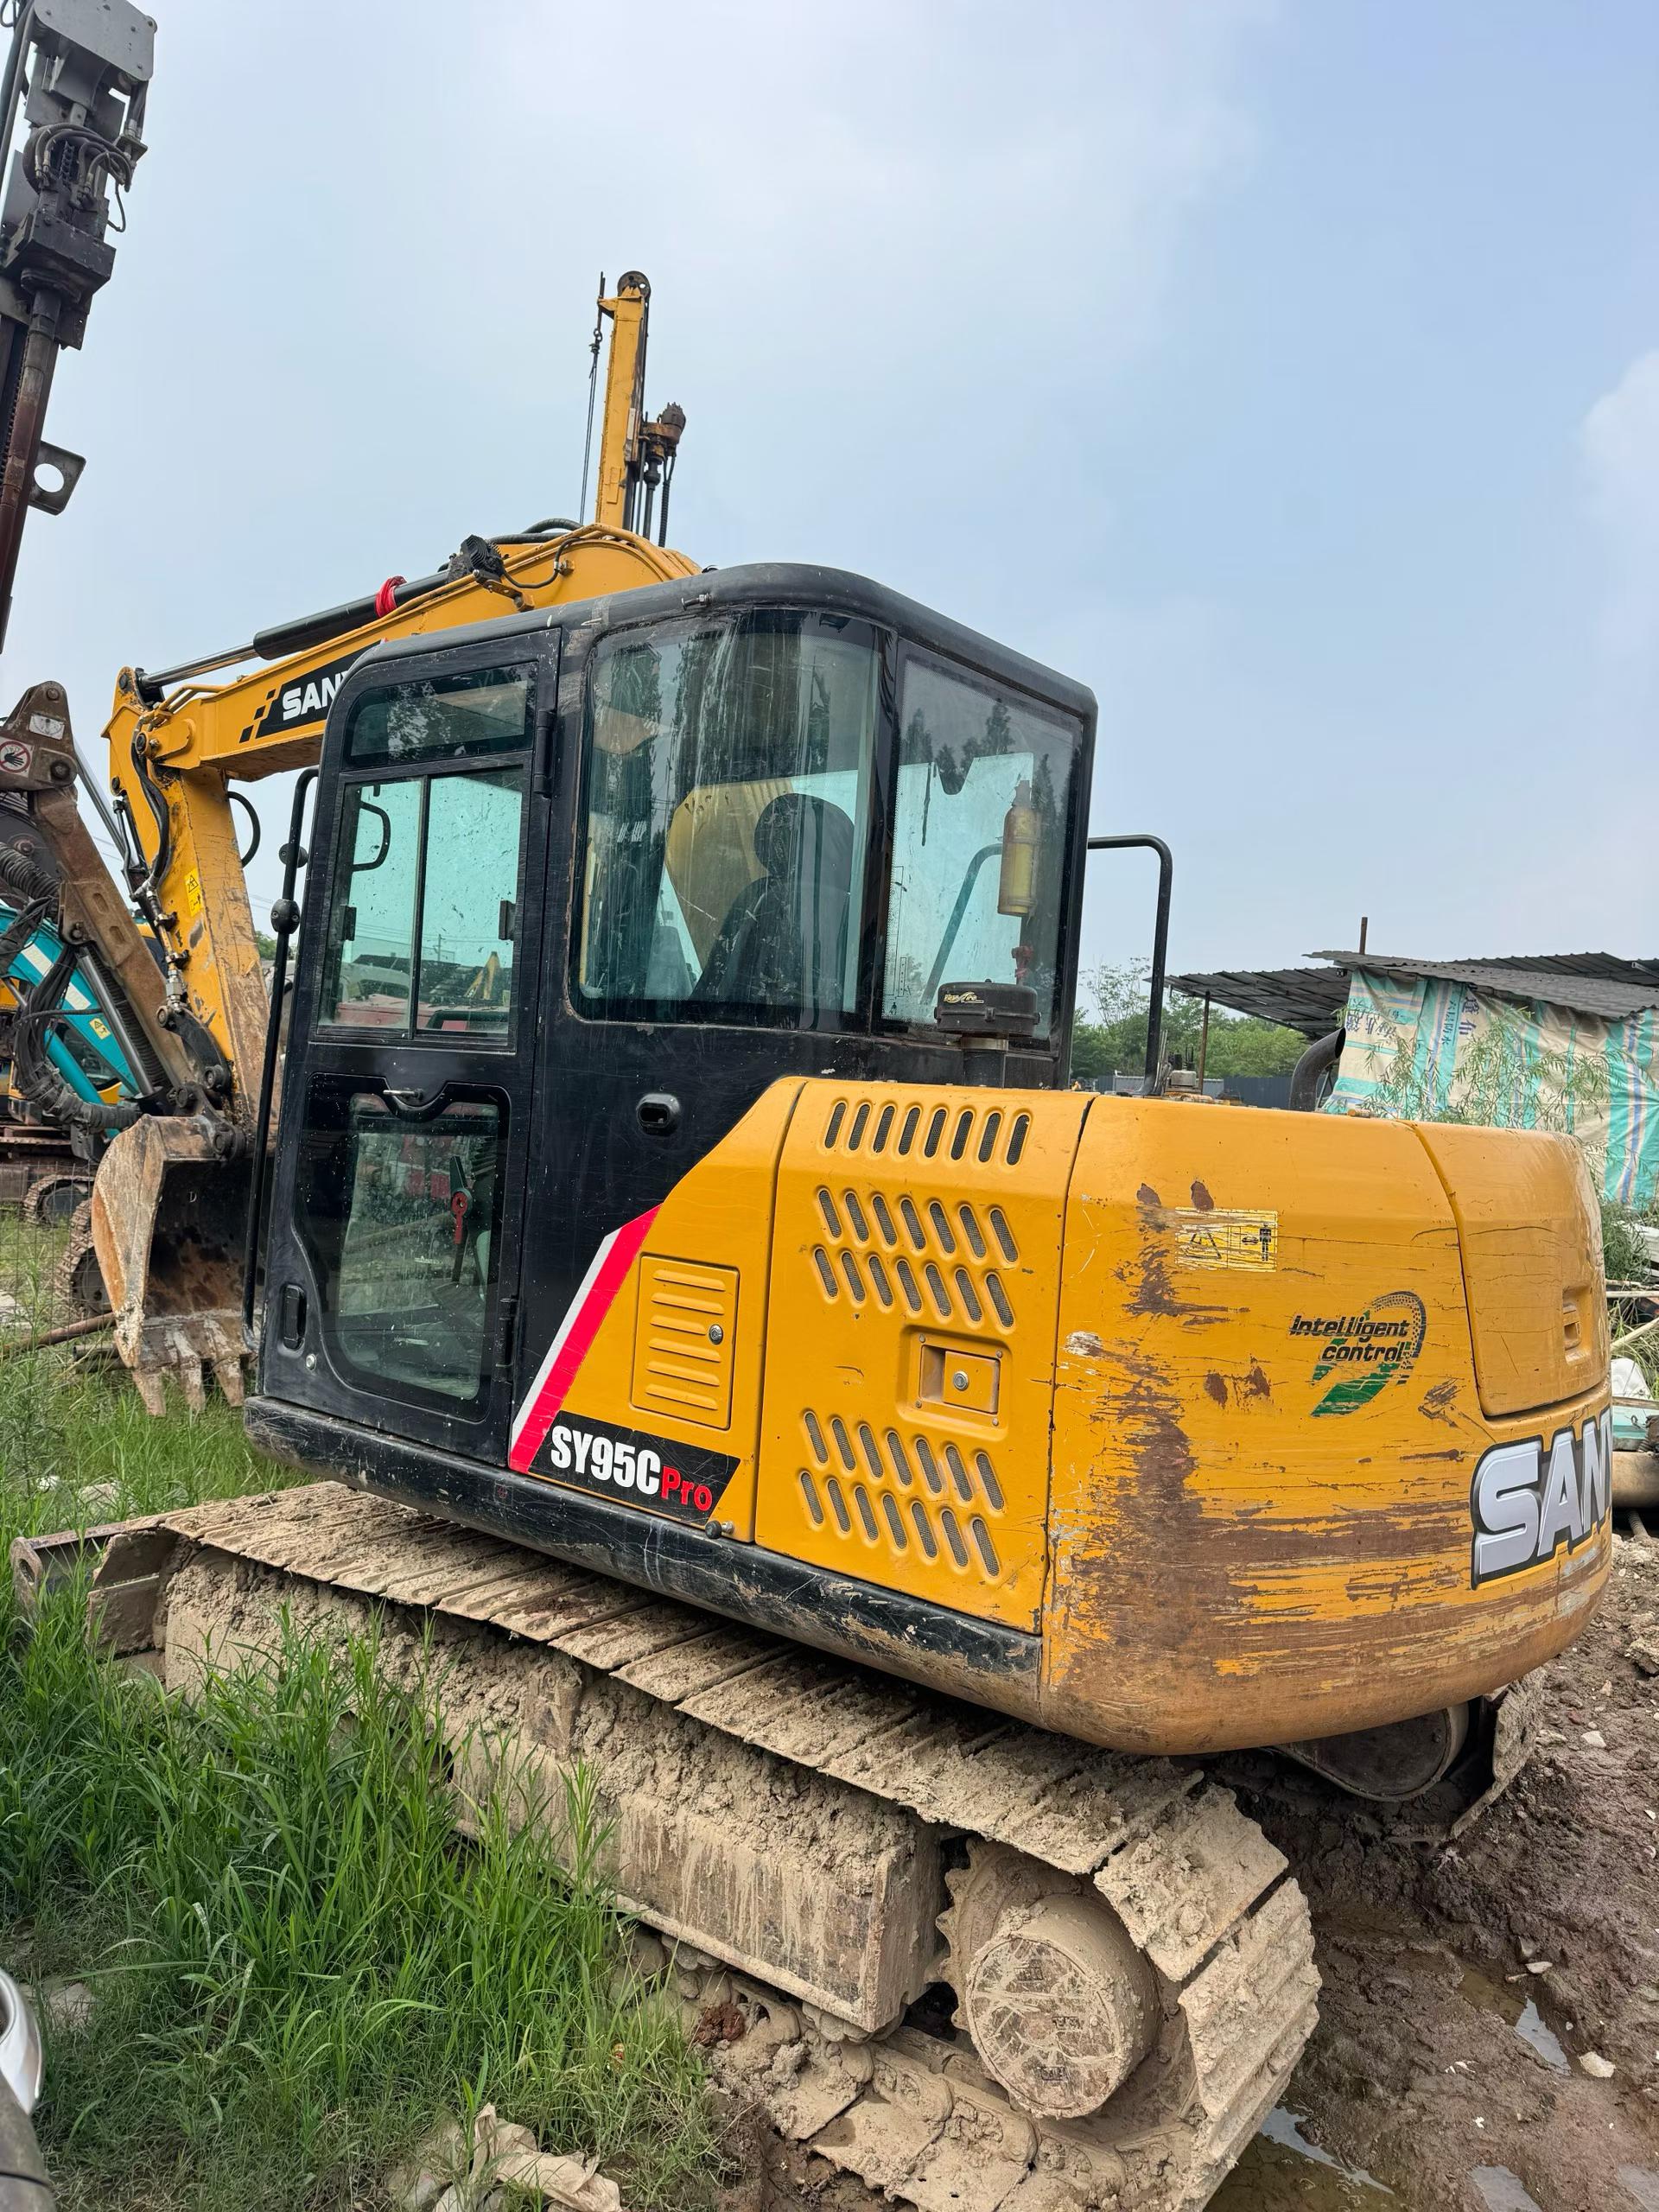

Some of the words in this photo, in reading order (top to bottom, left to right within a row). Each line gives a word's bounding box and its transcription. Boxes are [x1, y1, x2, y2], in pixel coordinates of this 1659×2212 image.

[1289, 1315, 1411, 1340] Intelligent
[1322, 1342, 1406, 1363] control
[1474, 1408, 1612, 1578] SAN
